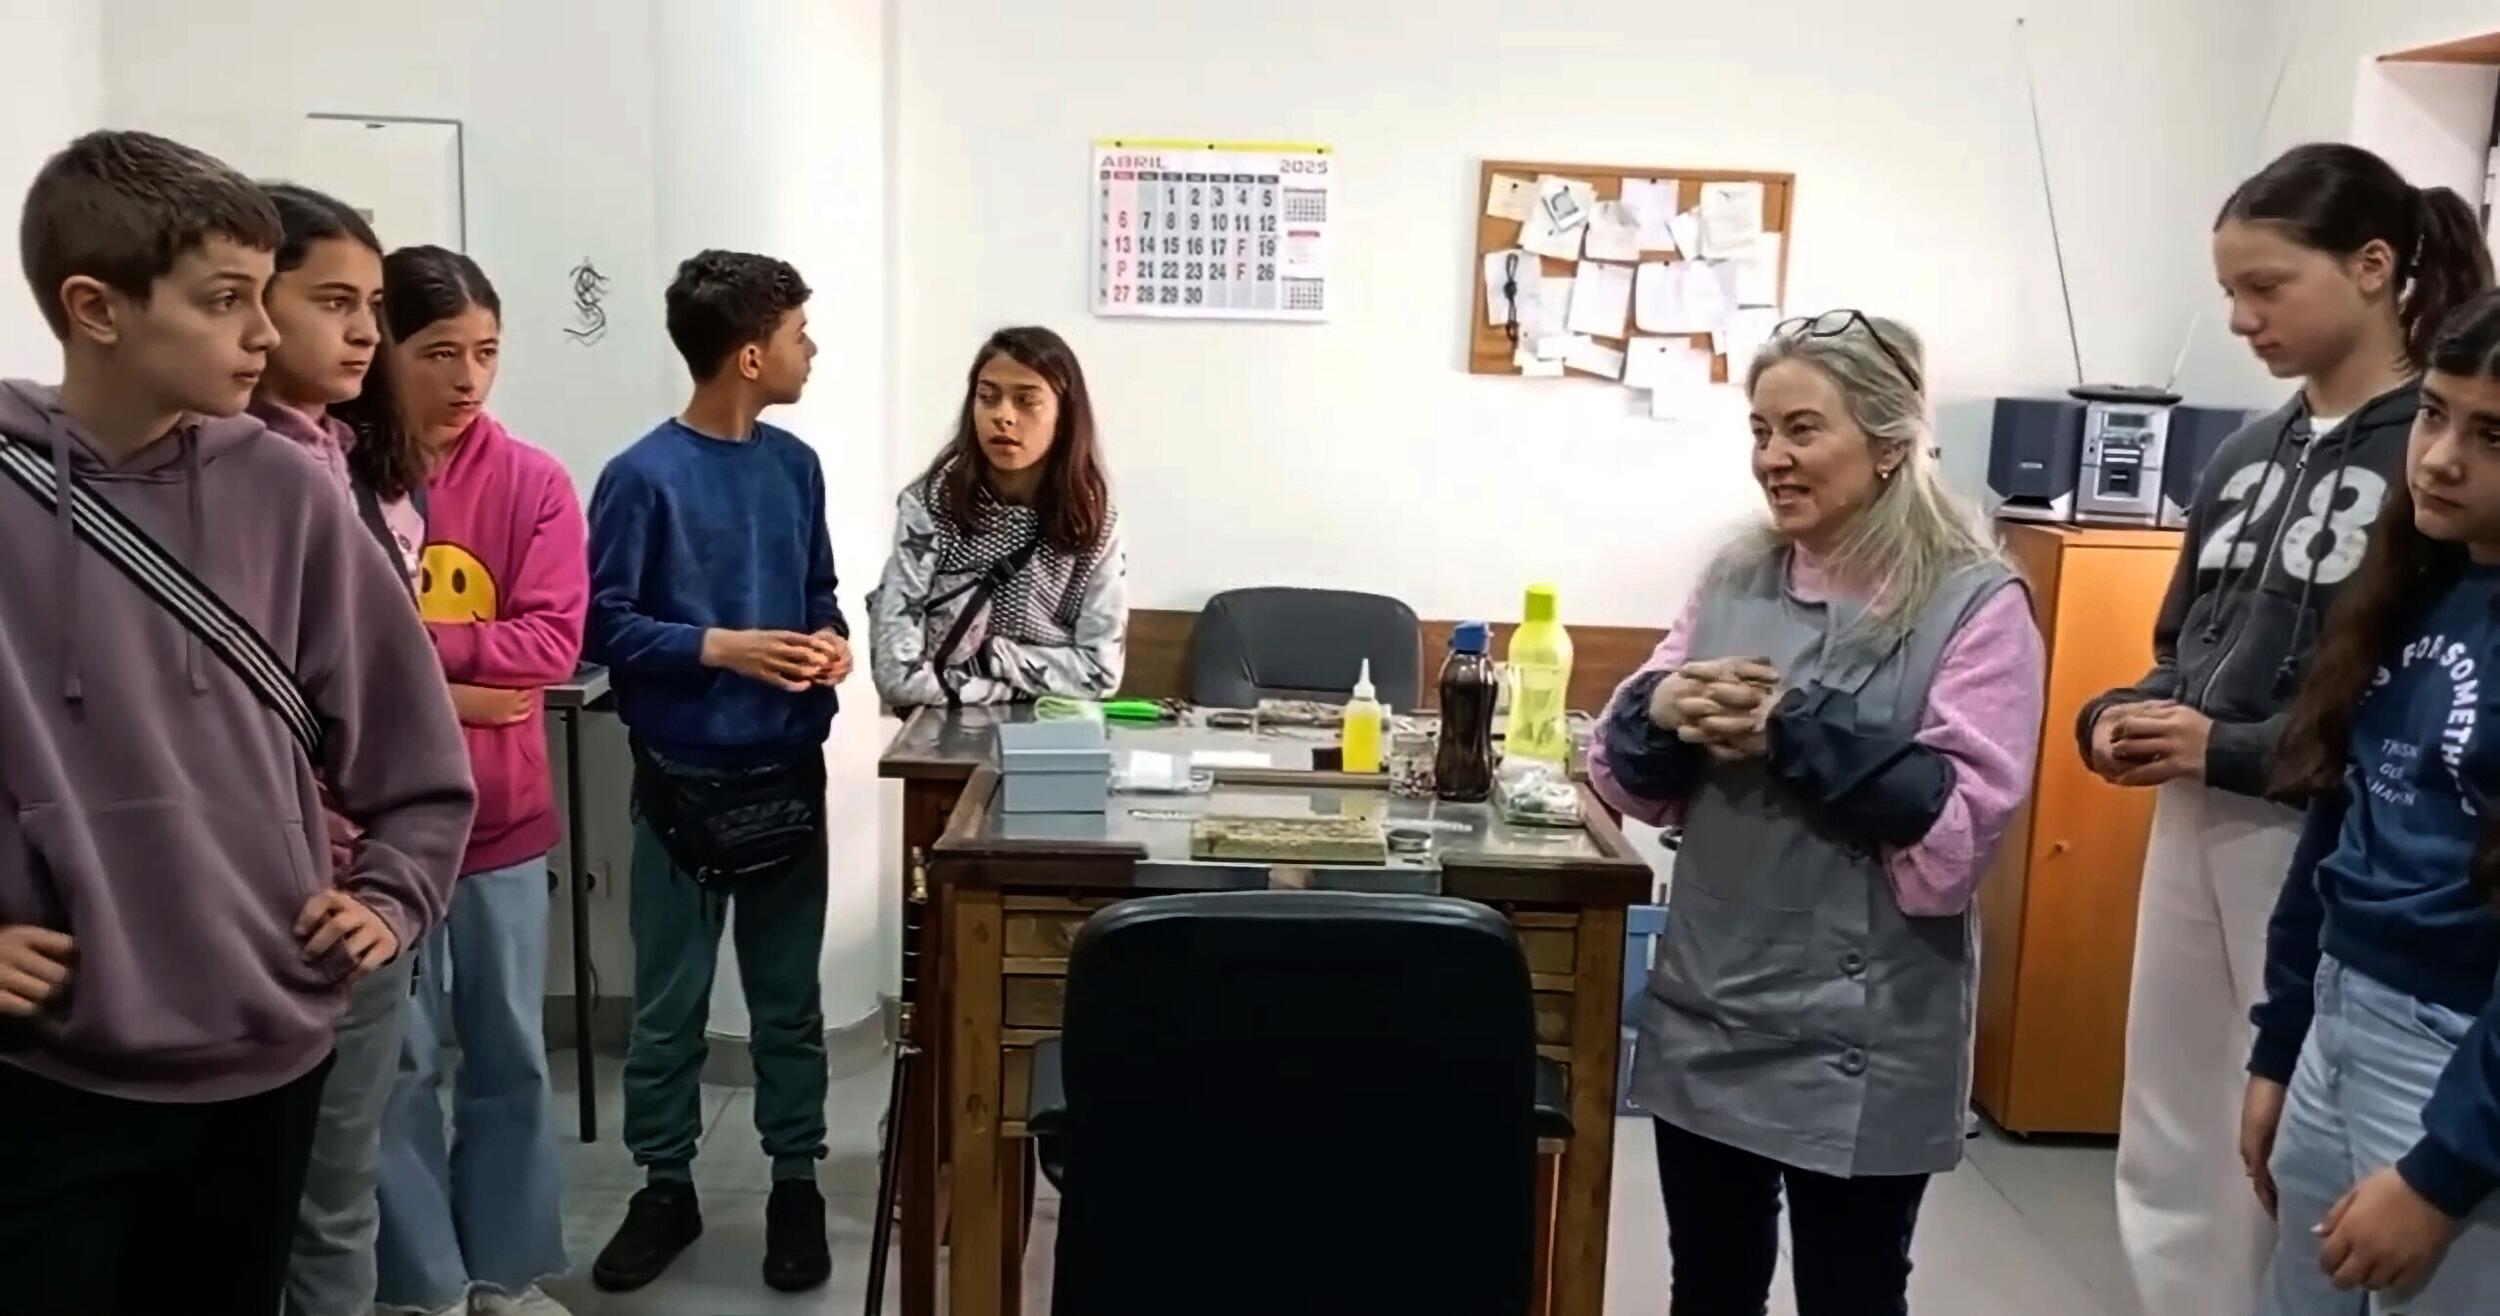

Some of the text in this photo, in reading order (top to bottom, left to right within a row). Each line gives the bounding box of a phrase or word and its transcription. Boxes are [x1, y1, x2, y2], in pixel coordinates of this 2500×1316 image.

[1101, 155, 1328, 174] ABRIL 2025
[1168, 188, 1175, 205] 1
[1191, 188, 1200, 206] 2
[1214, 188, 1224, 206] 3
[1238, 190, 1247, 205] 4
[1263, 190, 1272, 207] 5
[1119, 211, 1277, 232] 6 7 8 9 10 11 12
[1115, 236, 1131, 253] 13
[1139, 237, 1155, 254] 14
[1162, 237, 1179, 254] 15
[1187, 238, 1204, 255] 16
[1210, 238, 1226, 256] 17
[1237, 239, 1247, 257] F
[1258, 239, 1276, 257] 19
[1117, 261, 1274, 281] P 21 22 23 24 F 26
[1114, 285, 1203, 304] 27 28 29 30
[2198, 461, 2388, 584] 28
[2439, 642, 2480, 816] SOMETH
